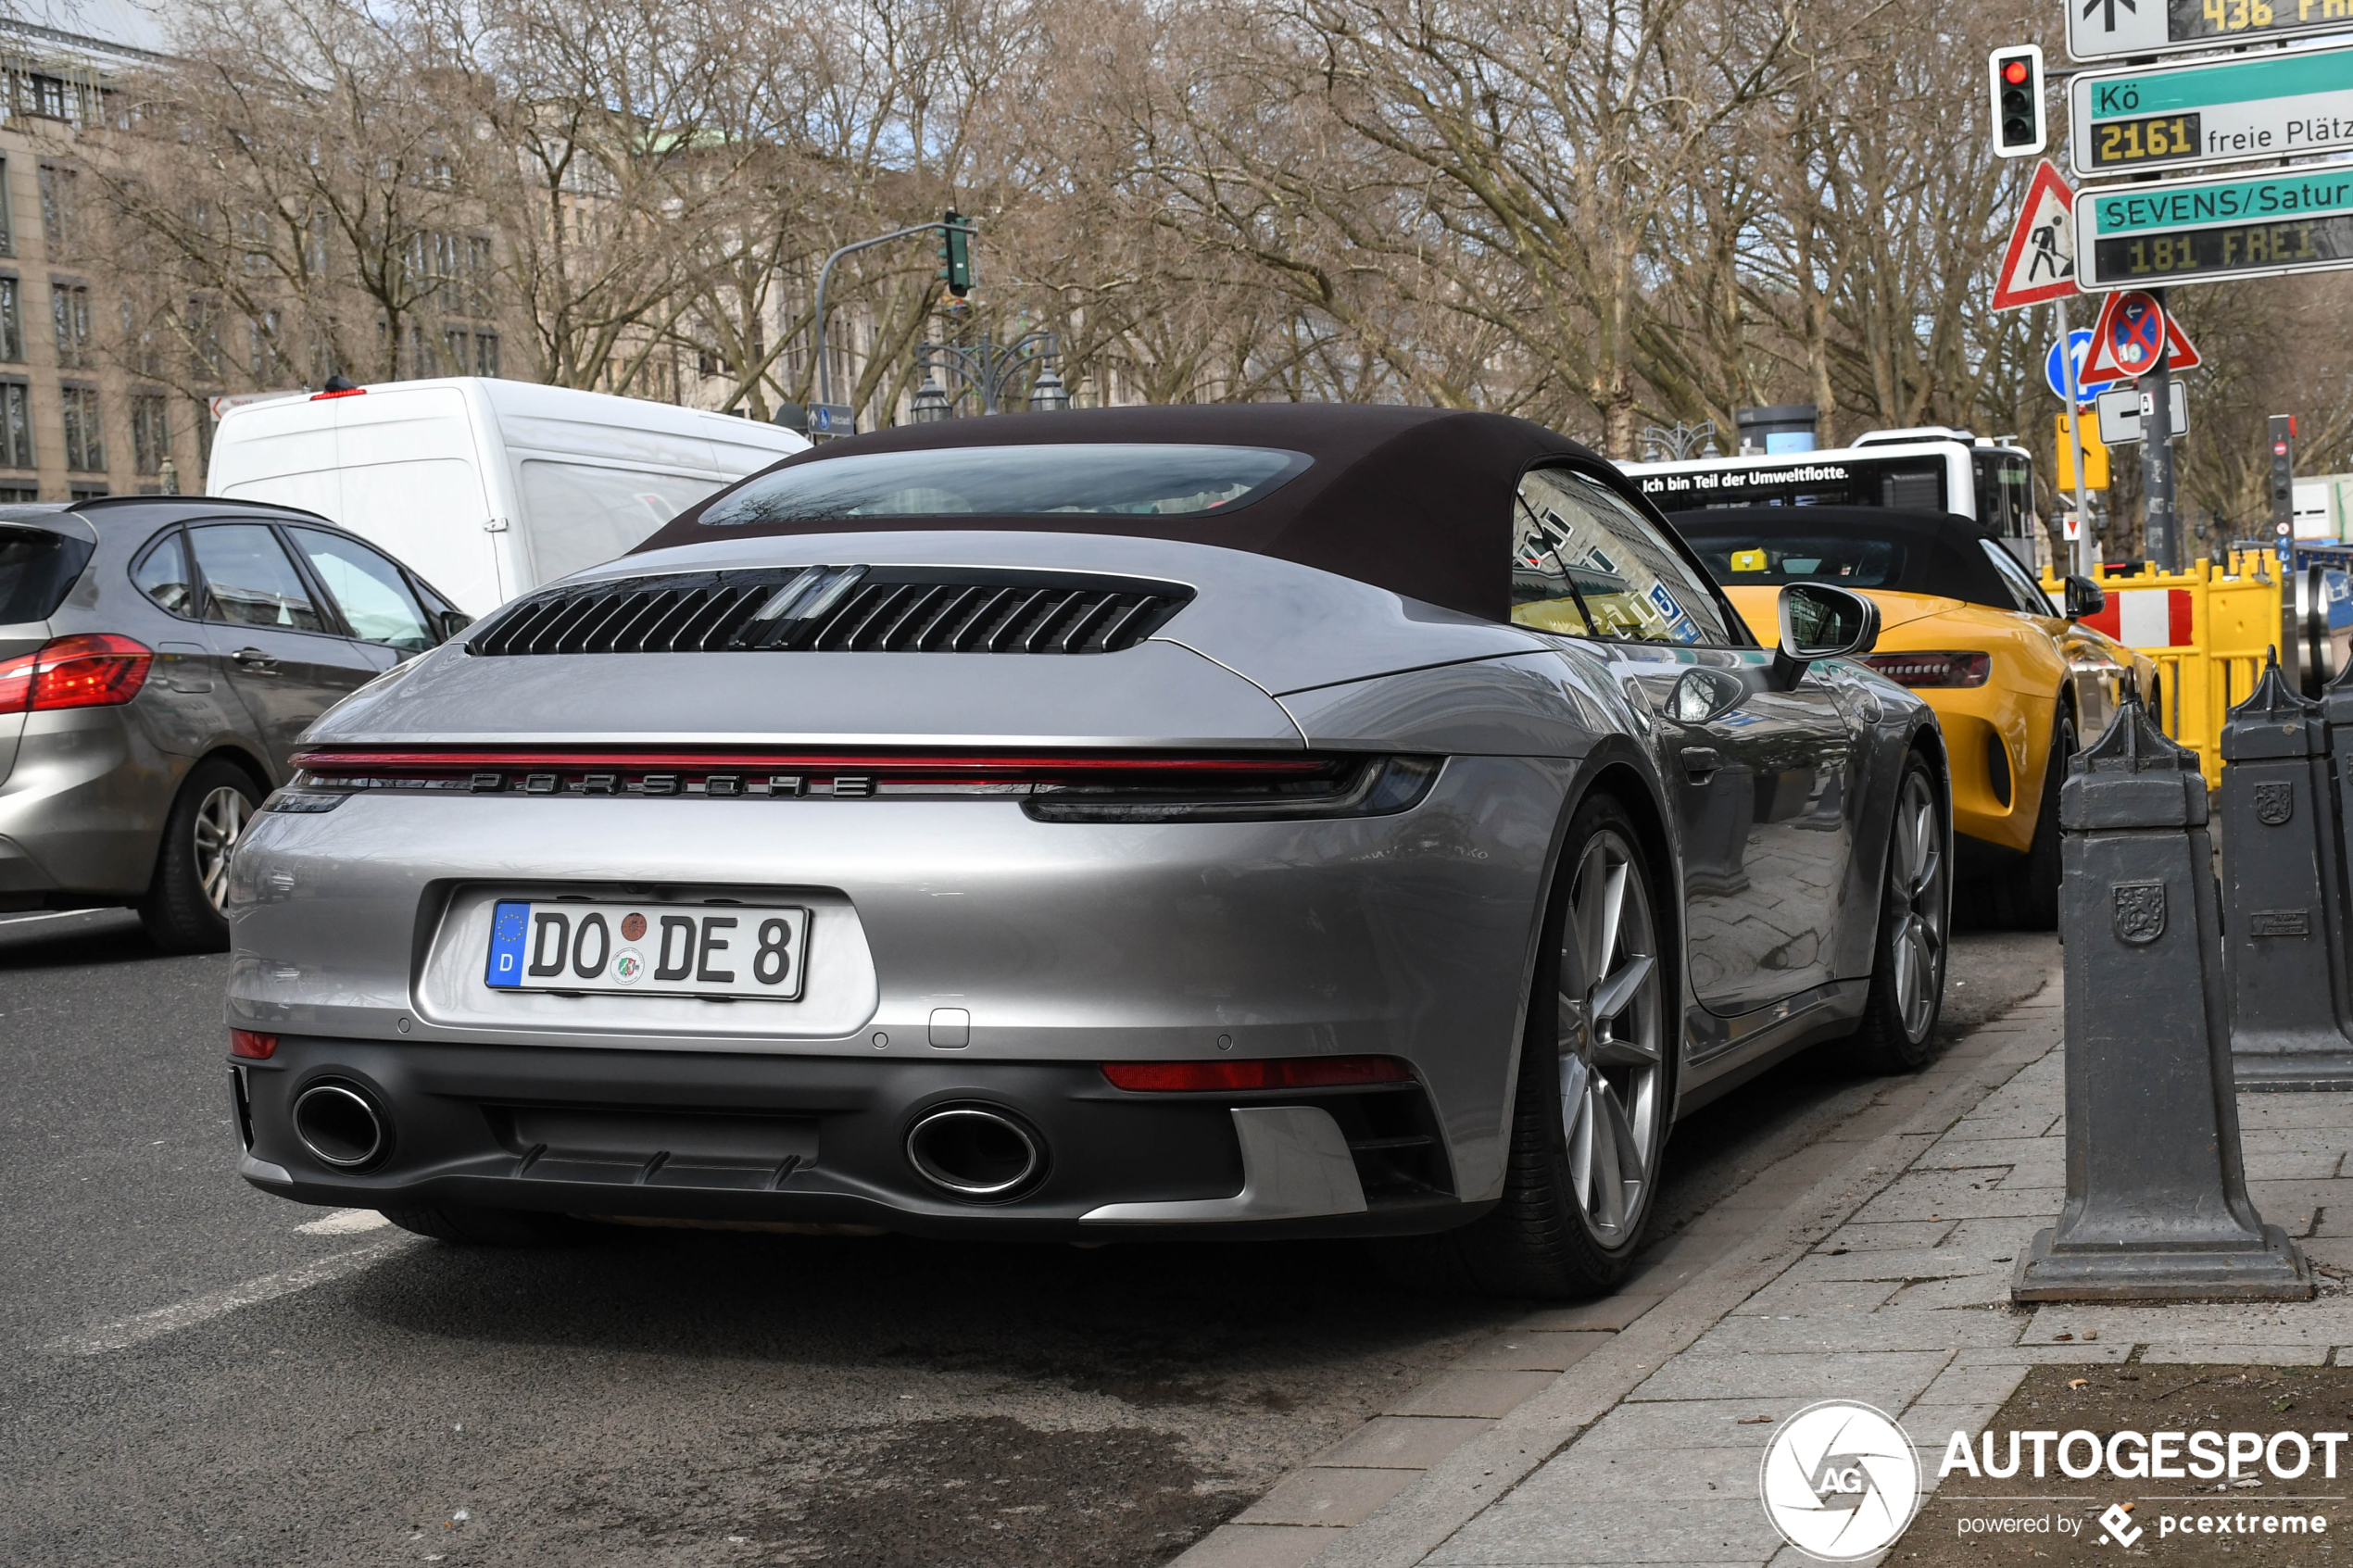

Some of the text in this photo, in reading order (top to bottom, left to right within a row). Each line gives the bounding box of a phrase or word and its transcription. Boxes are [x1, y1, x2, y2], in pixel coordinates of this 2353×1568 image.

[2204, 0, 2273, 31] 436
[2101, 83, 2140, 112] Kö
[2101, 118, 2192, 160] 2161
[2208, 126, 2271, 153] freie
[2106, 183, 2353, 228] SEVENS/Satur
[2131, 221, 2315, 273] 181 FREI
[1642, 466, 1849, 493] Ich bin Teil der Umweltflotte.
[470, 772, 871, 797] PORSCHE
[499, 953, 513, 972] D
[528, 912, 792, 985] DO DE 8
